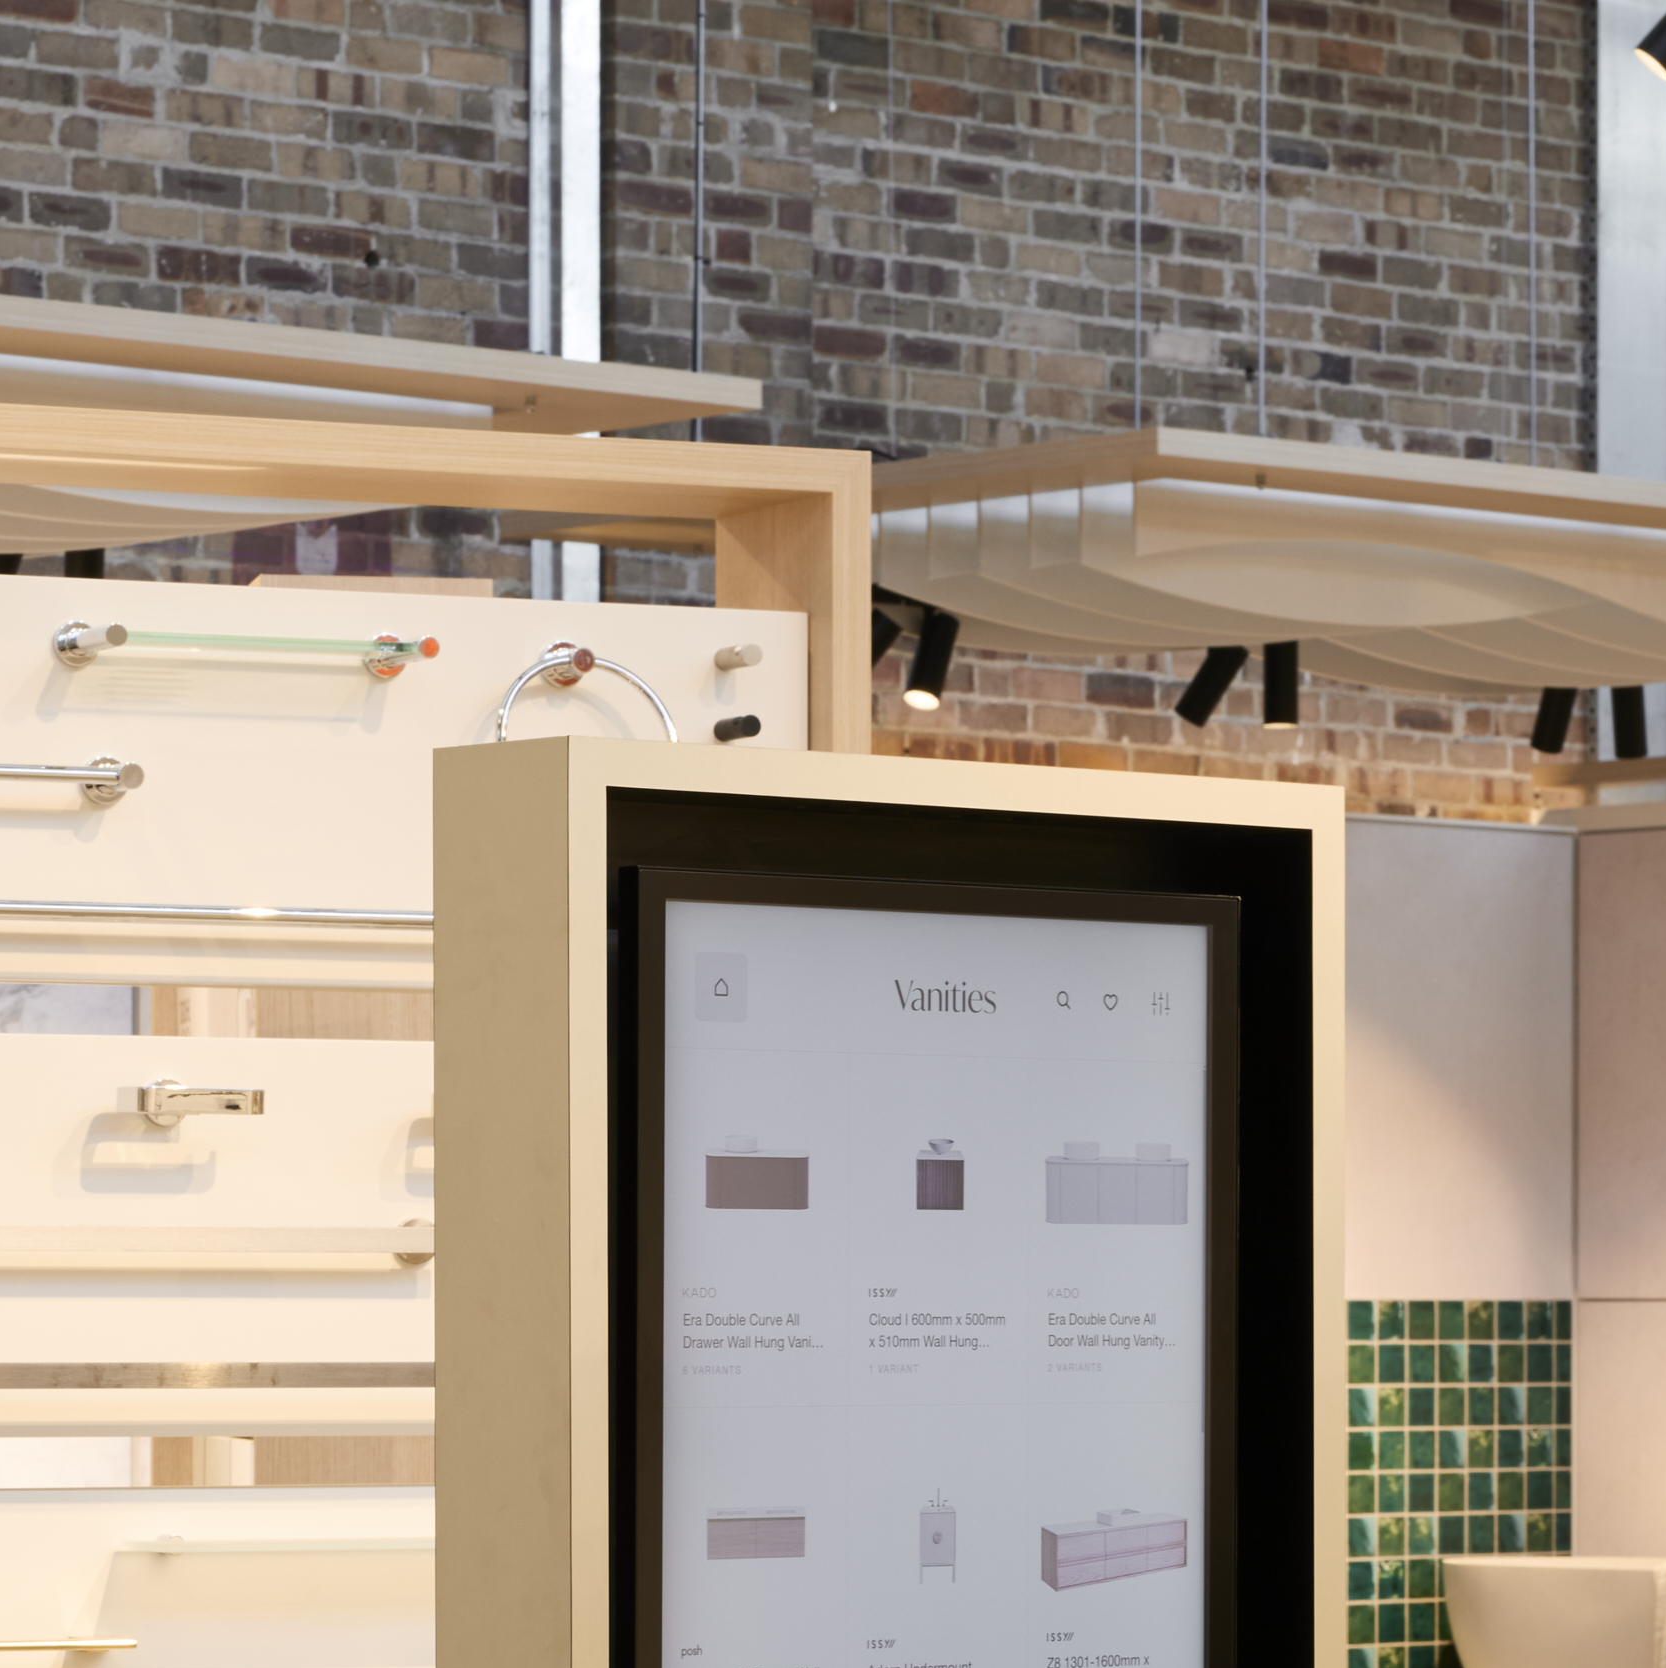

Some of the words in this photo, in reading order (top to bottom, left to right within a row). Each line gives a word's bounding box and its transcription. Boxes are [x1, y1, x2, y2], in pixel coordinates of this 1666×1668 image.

[894, 979, 997, 1013] Vanities
[682, 1288, 717, 1299] KADO
[1047, 1288, 1079, 1299] KADO
[683, 1314, 702, 1326] Era
[705, 1314, 746, 1326] Double
[750, 1314, 782, 1326] Curve
[786, 1314, 800, 1326] All
[869, 1314, 901, 1326] Cloud
[911, 1314, 952, 1326] 600mm
[955, 1316, 962, 1326] x
[965, 1314, 1006, 1326] 500mm
[1048, 1313, 1066, 1325] Era
[1069, 1313, 1107, 1325] Double
[1109, 1313, 1140, 1325] Curve
[1143, 1313, 1156, 1325] All
[683, 1336, 724, 1349] Drawer
[727, 1336, 750, 1348] Wall
[755, 1336, 784, 1351] Hung
[869, 1338, 875, 1348] x
[878, 1336, 920, 1348] 510mm
[923, 1336, 945, 1347] Wall
[1048, 1335, 1074, 1347] Door
[1077, 1335, 1099, 1346] Wall
[1102, 1335, 1130, 1349] Hung
[692, 1366, 741, 1375] VARIANTS
[878, 1364, 919, 1373] VARIANT
[1048, 1364, 1053, 1372] 2
[1056, 1363, 1102, 1372] VARIANTS
[681, 1645, 703, 1659] posh
[1143, 1656, 1150, 1665] x
